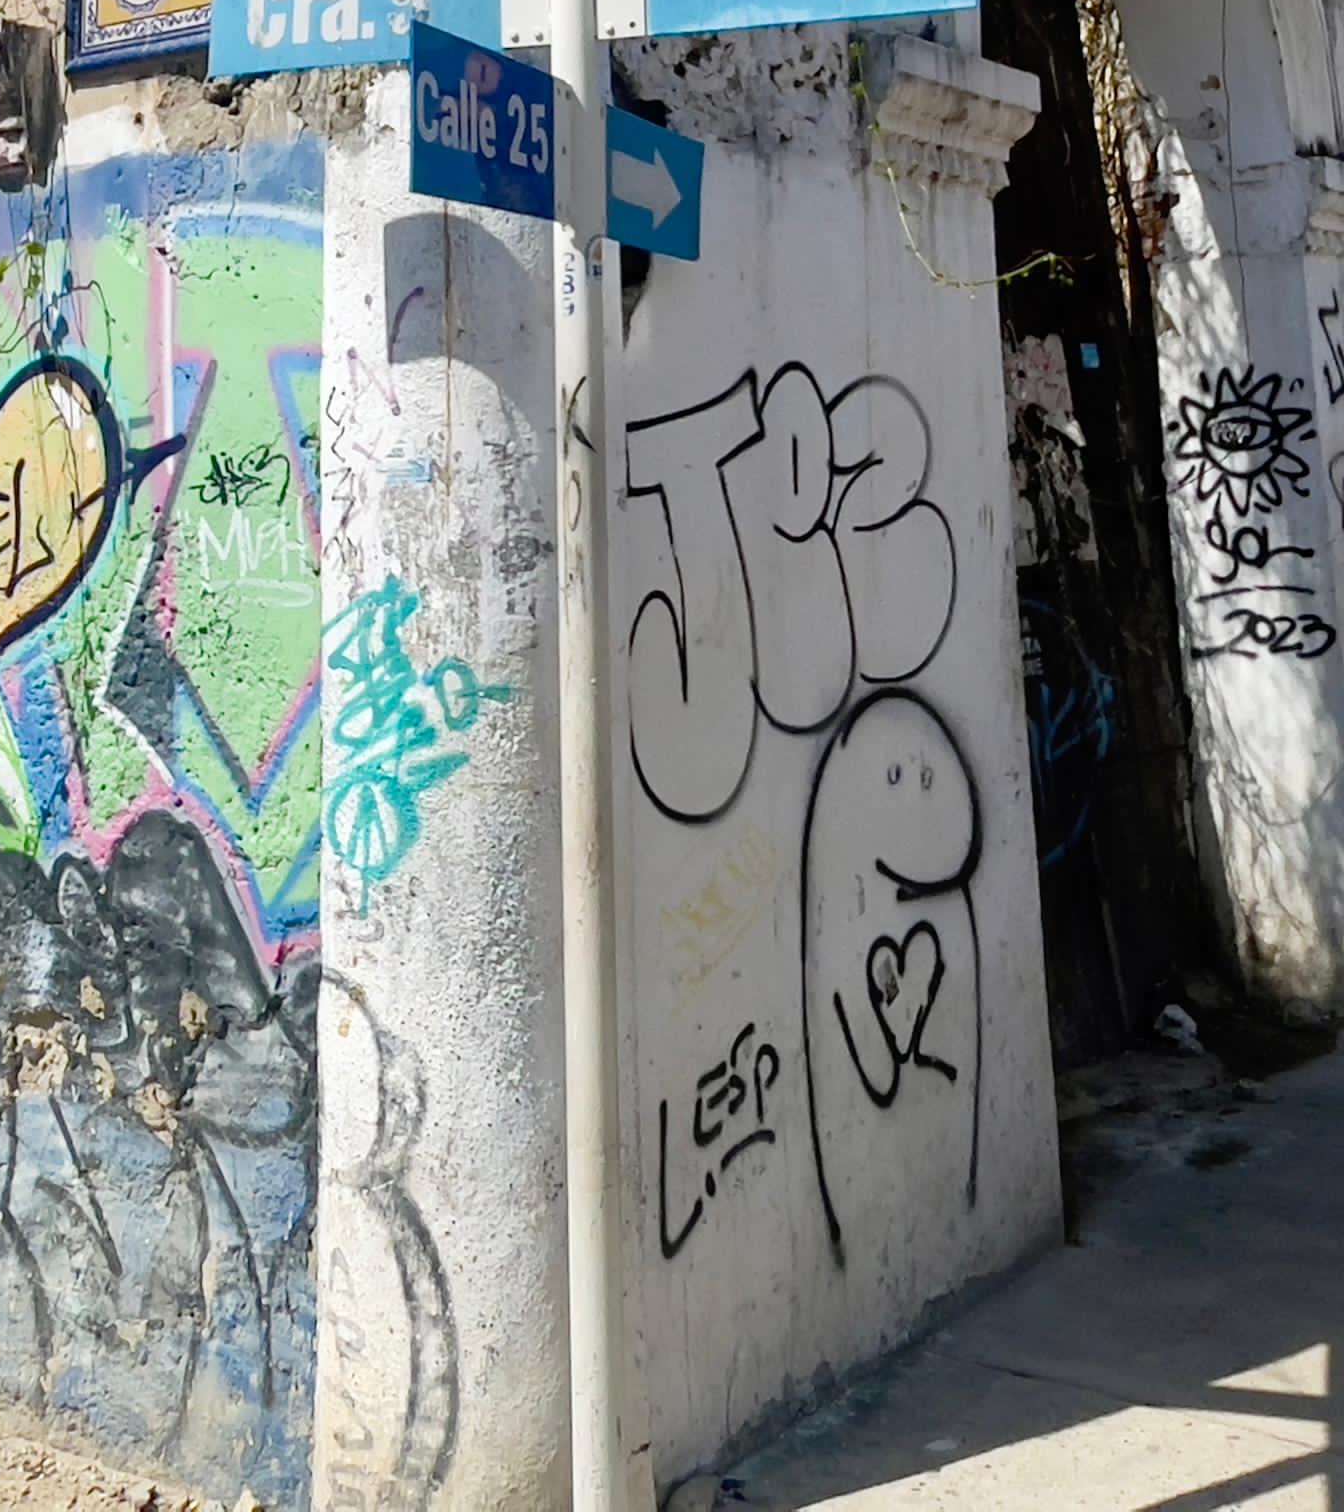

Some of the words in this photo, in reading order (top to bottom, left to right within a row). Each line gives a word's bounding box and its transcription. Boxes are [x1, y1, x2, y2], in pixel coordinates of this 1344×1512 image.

[416, 70, 497, 159] Calle
[507, 93, 550, 174] 25
[1192, 609, 1337, 659] 2023
